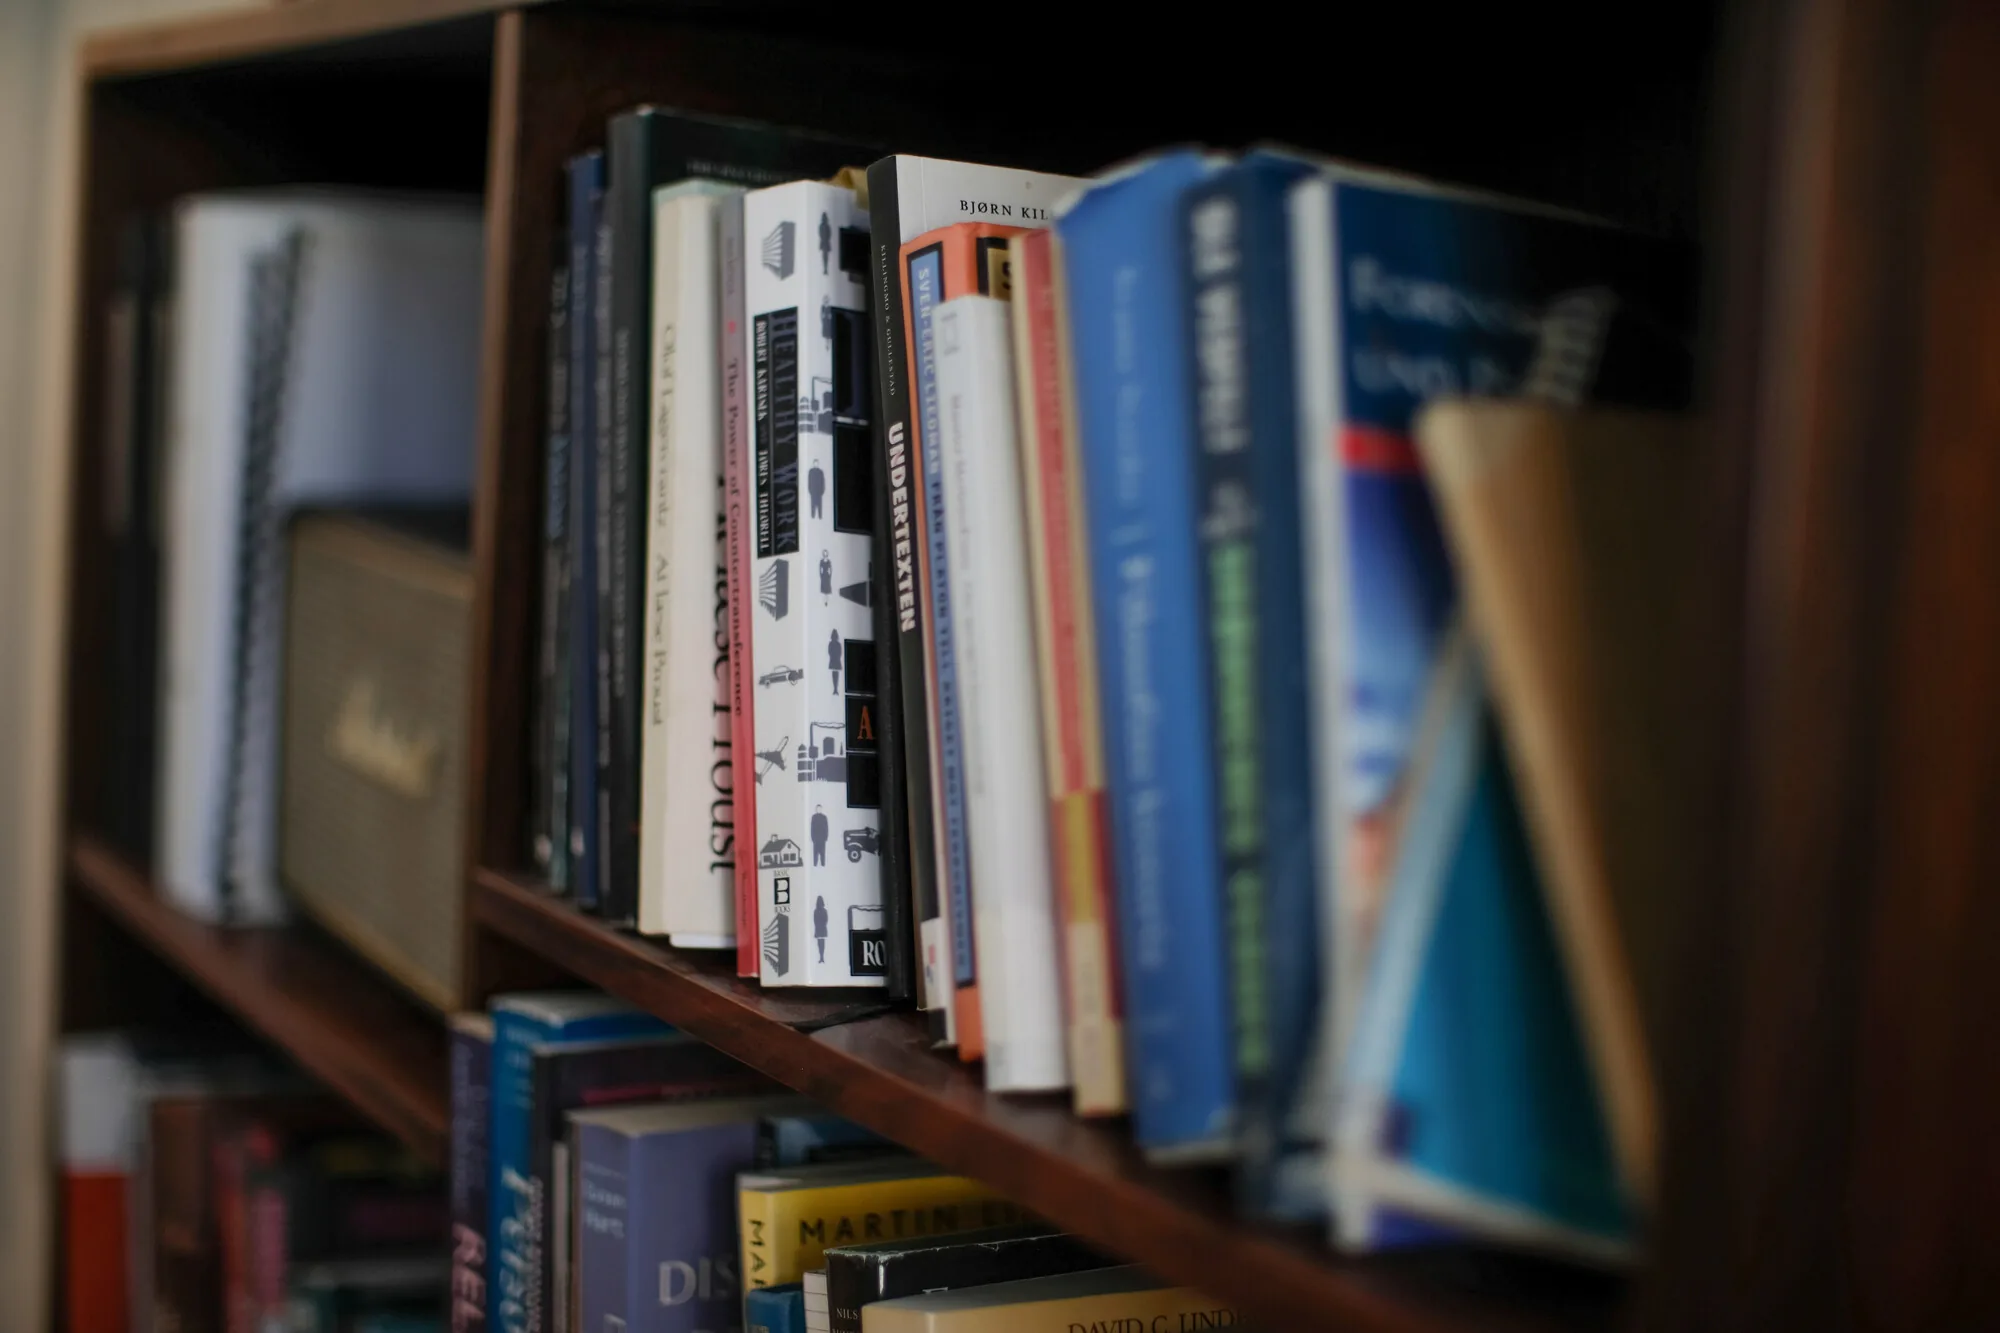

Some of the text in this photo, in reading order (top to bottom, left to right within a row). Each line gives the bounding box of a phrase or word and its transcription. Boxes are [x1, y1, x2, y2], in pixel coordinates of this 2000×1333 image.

[959, 199, 1049, 220] BJØRN KIL
[879, 244, 890, 311] KILLINGMO
[886, 328, 897, 397] GULLESTAD
[770, 314, 798, 549] HEALTHY WORK
[727, 357, 745, 716] The Power of Countertransference
[888, 421, 916, 633] UNDERTEXTEN
[857, 704, 876, 740] A
[798, 1204, 960, 1246] MARTIN
[1179, 1307, 1240, 1333] LIND
